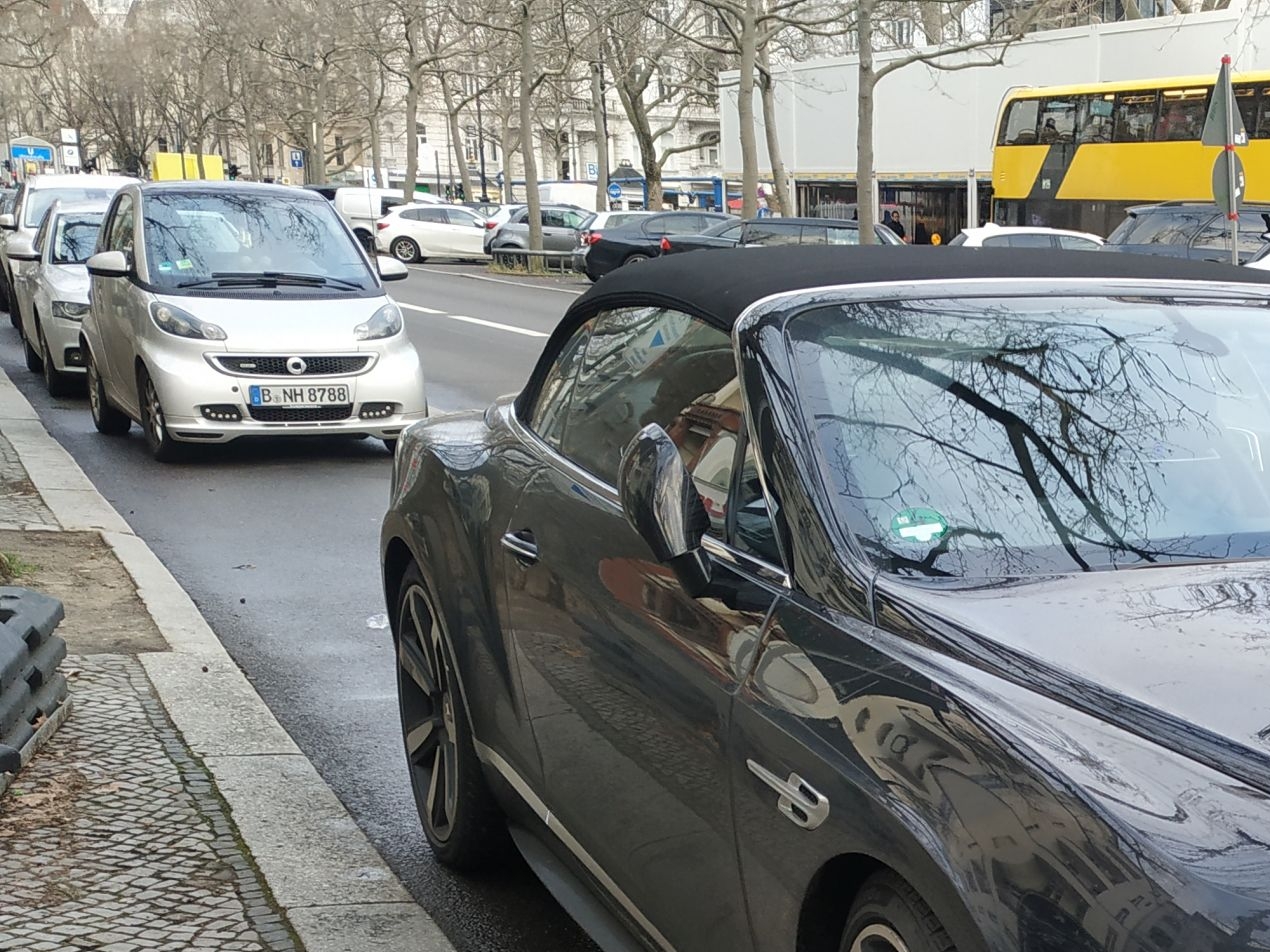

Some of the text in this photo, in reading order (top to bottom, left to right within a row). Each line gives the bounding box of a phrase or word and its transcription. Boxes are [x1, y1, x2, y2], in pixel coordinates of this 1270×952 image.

[261, 388, 272, 403] B
[282, 388, 304, 403] NH
[308, 387, 347, 403] 8788
